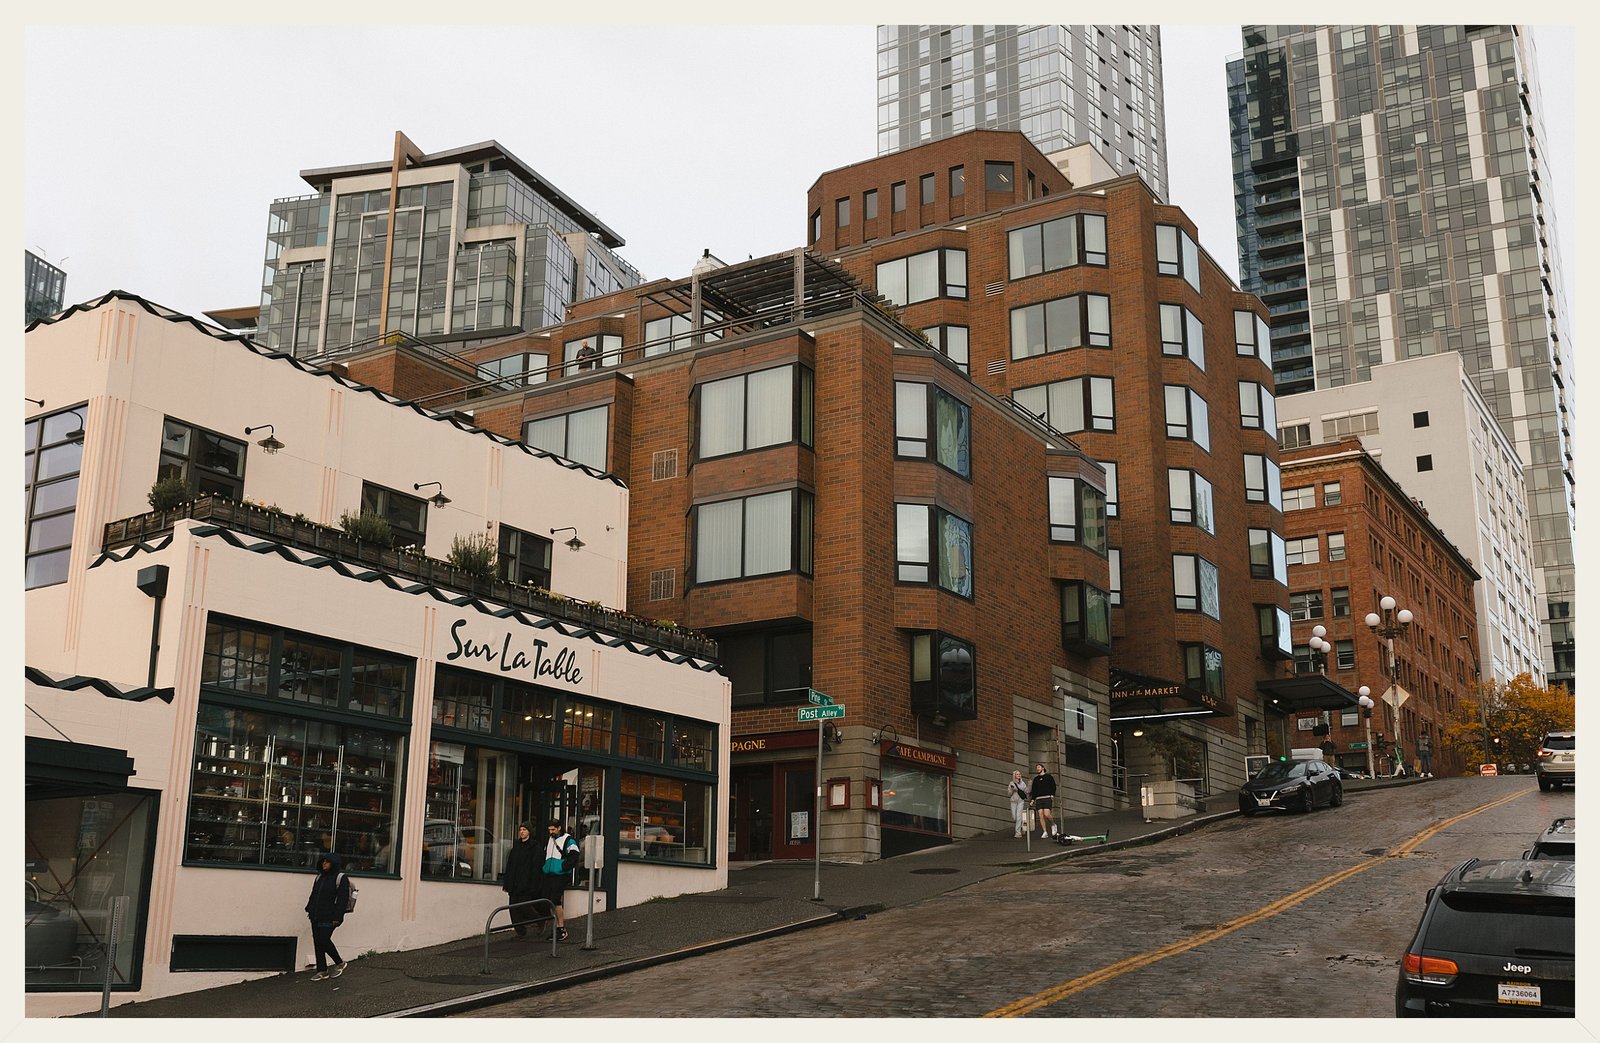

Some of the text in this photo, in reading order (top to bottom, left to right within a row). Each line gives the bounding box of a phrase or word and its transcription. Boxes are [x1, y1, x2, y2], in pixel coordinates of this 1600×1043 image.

[447, 619, 583, 684] Sur La Table
[811, 691, 821, 704] Pine
[1111, 691, 1128, 699] INN
[1144, 686, 1180, 696] MARKET
[800, 708, 818, 719] Post
[730, 739, 766, 751] PAGNE
[912, 749, 946, 765] CAMPAGNE
[1503, 962, 1531, 974] Jeep
[1502, 989, 1537, 997] A7736064
